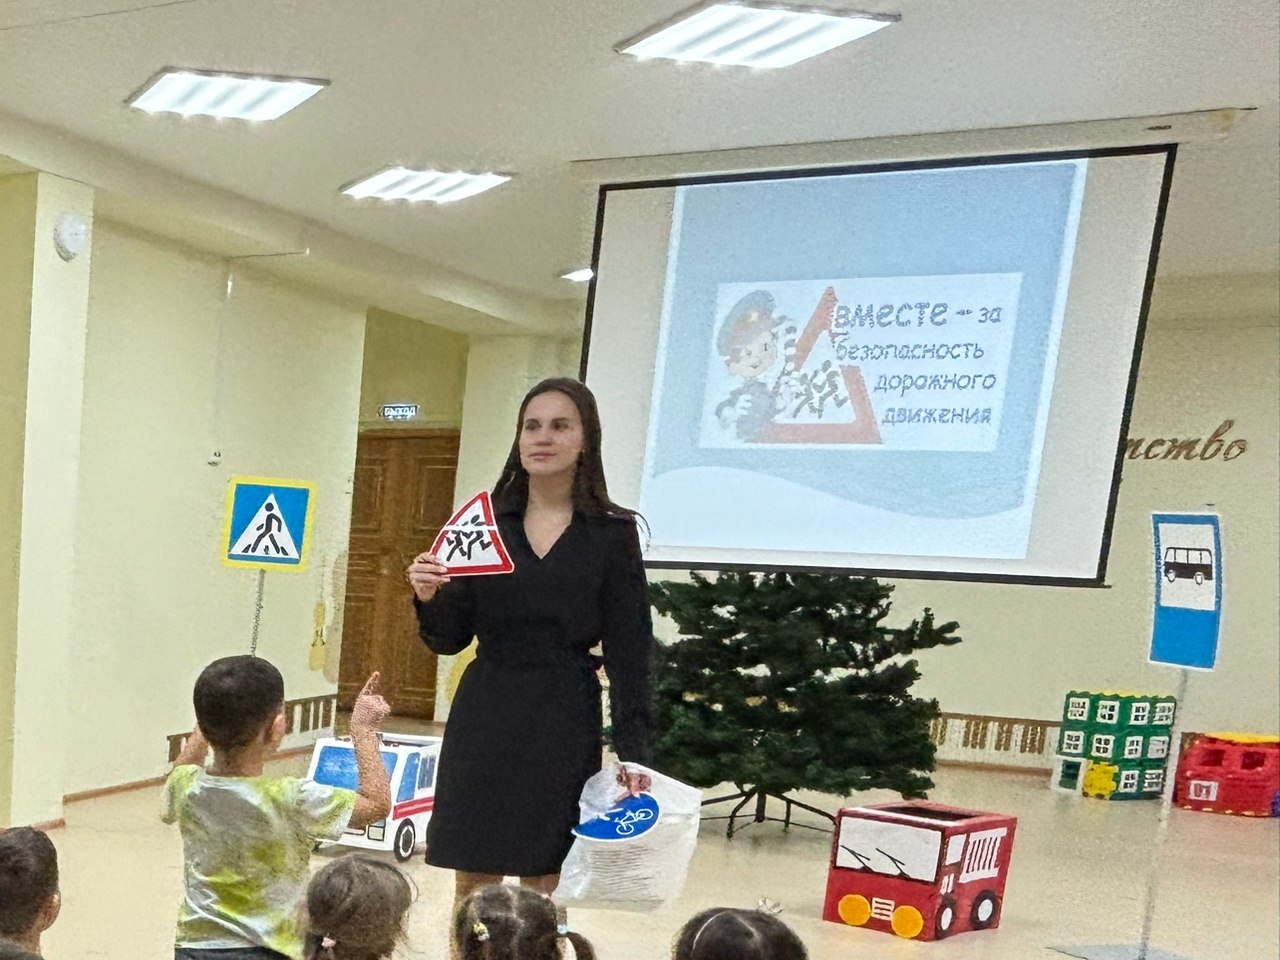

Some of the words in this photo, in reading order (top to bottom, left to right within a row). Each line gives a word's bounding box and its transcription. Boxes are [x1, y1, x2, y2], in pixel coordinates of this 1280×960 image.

[978, 307, 1003, 324] за
[836, 336, 985, 361] безопасность
[874, 373, 997, 397] дорожного
[882, 407, 992, 426] движения
